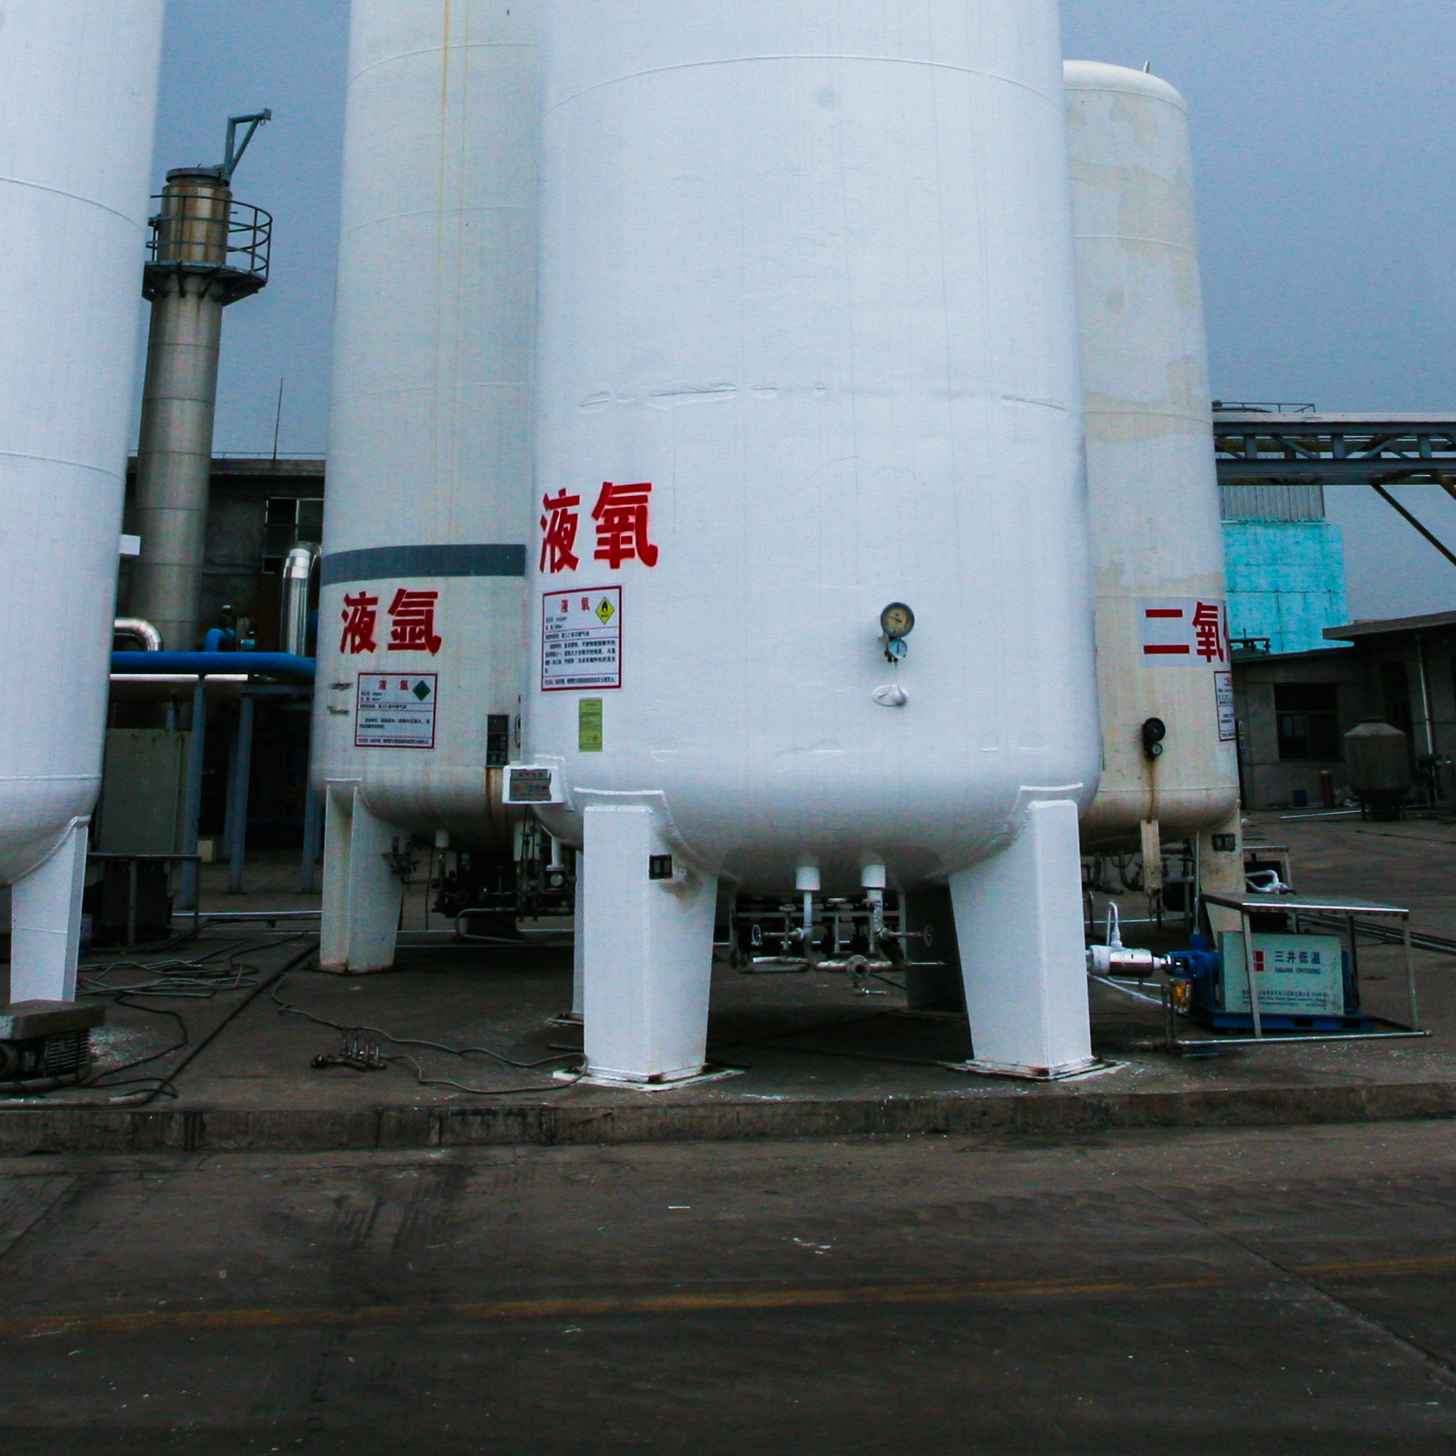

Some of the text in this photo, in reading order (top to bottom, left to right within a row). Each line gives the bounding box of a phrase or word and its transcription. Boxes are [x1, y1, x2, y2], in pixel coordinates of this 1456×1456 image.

[539, 481, 659, 573] 液氧
[339, 587, 442, 656] 液氩
[1143, 600, 1230, 663] 二氧
